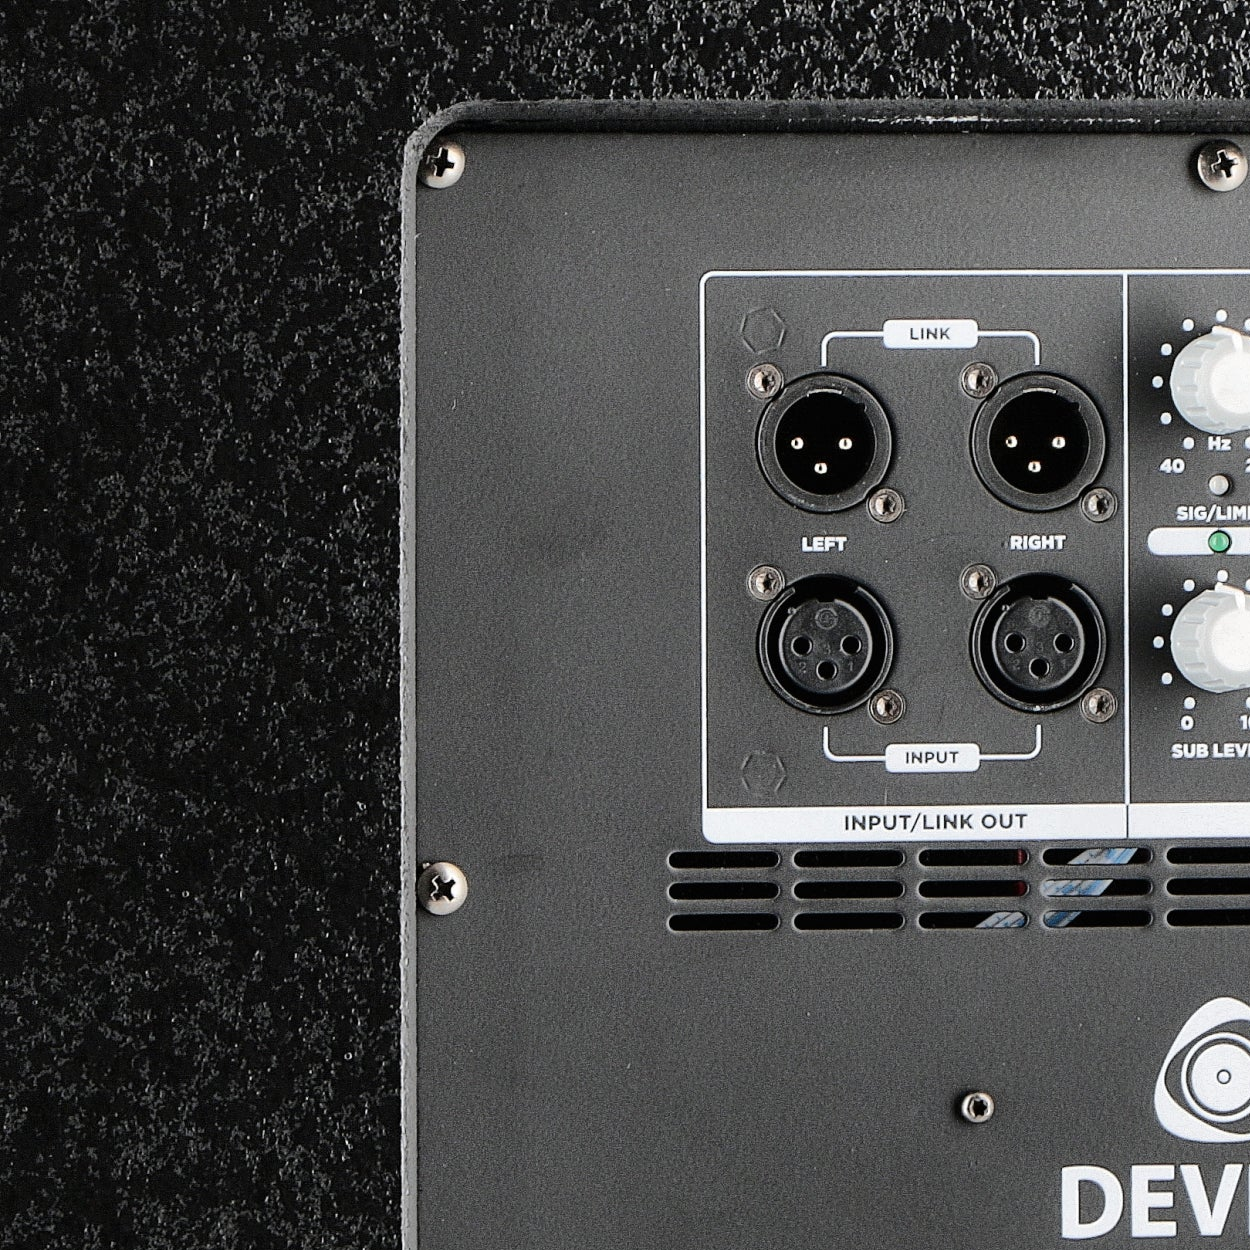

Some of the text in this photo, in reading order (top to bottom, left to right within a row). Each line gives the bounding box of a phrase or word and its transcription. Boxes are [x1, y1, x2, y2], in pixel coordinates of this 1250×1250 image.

[911, 328, 949, 340] LINK
[1208, 436, 1231, 450] Hz
[1160, 459, 1184, 473] 40
[802, 537, 847, 551] LEFT
[1011, 535, 1066, 550] RIGHT
[1181, 716, 1193, 730] 0
[906, 752, 958, 763] INPUT
[1172, 744, 1208, 758] SUB
[846, 813, 1027, 832] INPUT/LINK OUT
